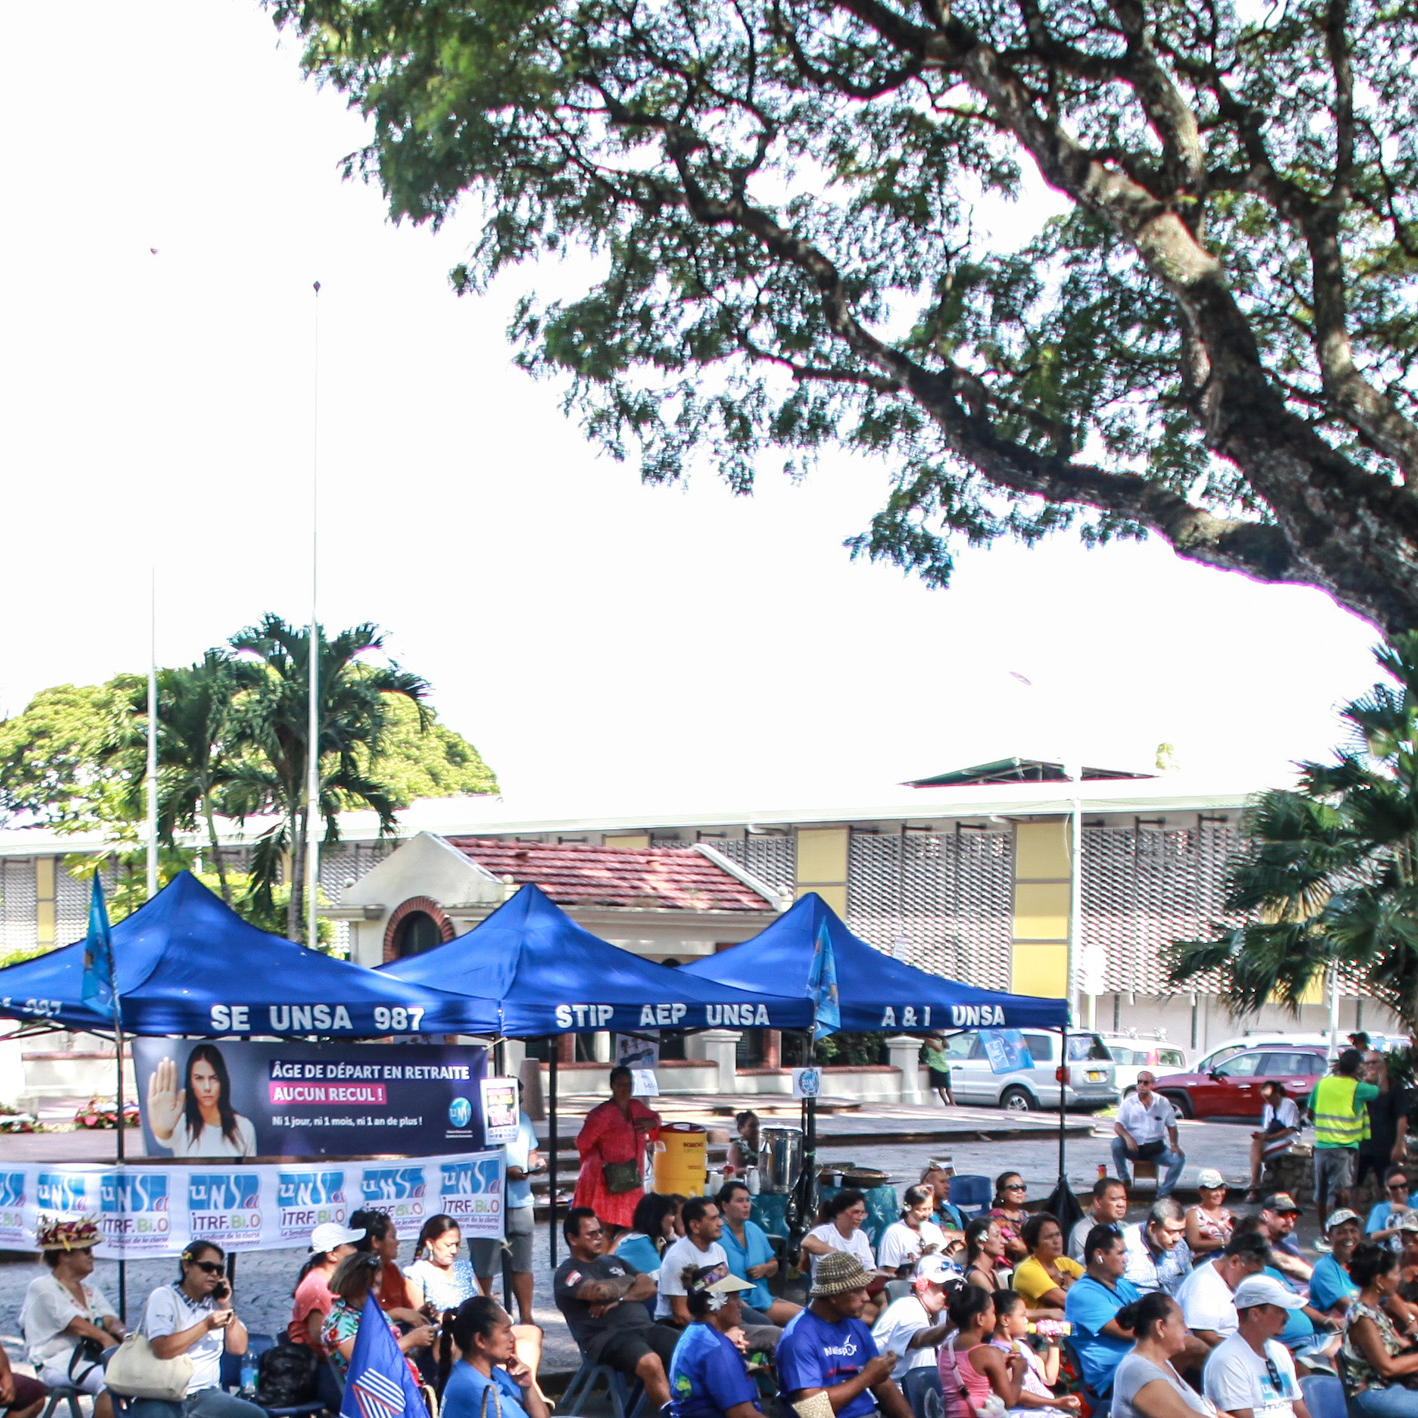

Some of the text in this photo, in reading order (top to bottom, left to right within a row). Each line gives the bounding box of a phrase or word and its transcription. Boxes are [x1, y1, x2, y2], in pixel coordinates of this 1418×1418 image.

[210, 1003, 425, 1032] SE UNSA 987
[555, 1003, 771, 1029] STIP AEP UNSA
[881, 1006, 897, 1028] A
[901, 1006, 917, 1028] &
[951, 1004, 1006, 1026] UNSA
[271, 1060, 471, 1081] ÂGE DE DÉPART EN RETRAITE
[273, 1087, 326, 1101] AUCUN
[328, 1087, 376, 1101] RECUL
[272, 1116, 283, 1126] Ni
[284, 1116, 290, 1126] 1
[290, 1116, 313, 1129] jour,
[313, 1116, 323, 1126] ni
[324, 1116, 330, 1126] 1
[331, 1117, 356, 1128] mois,
[356, 1117, 366, 1126] ni
[367, 1117, 373, 1126] 1
[374, 1118, 385, 1126] an
[386, 1116, 398, 1126] de
[399, 1116, 418, 1128] plus
